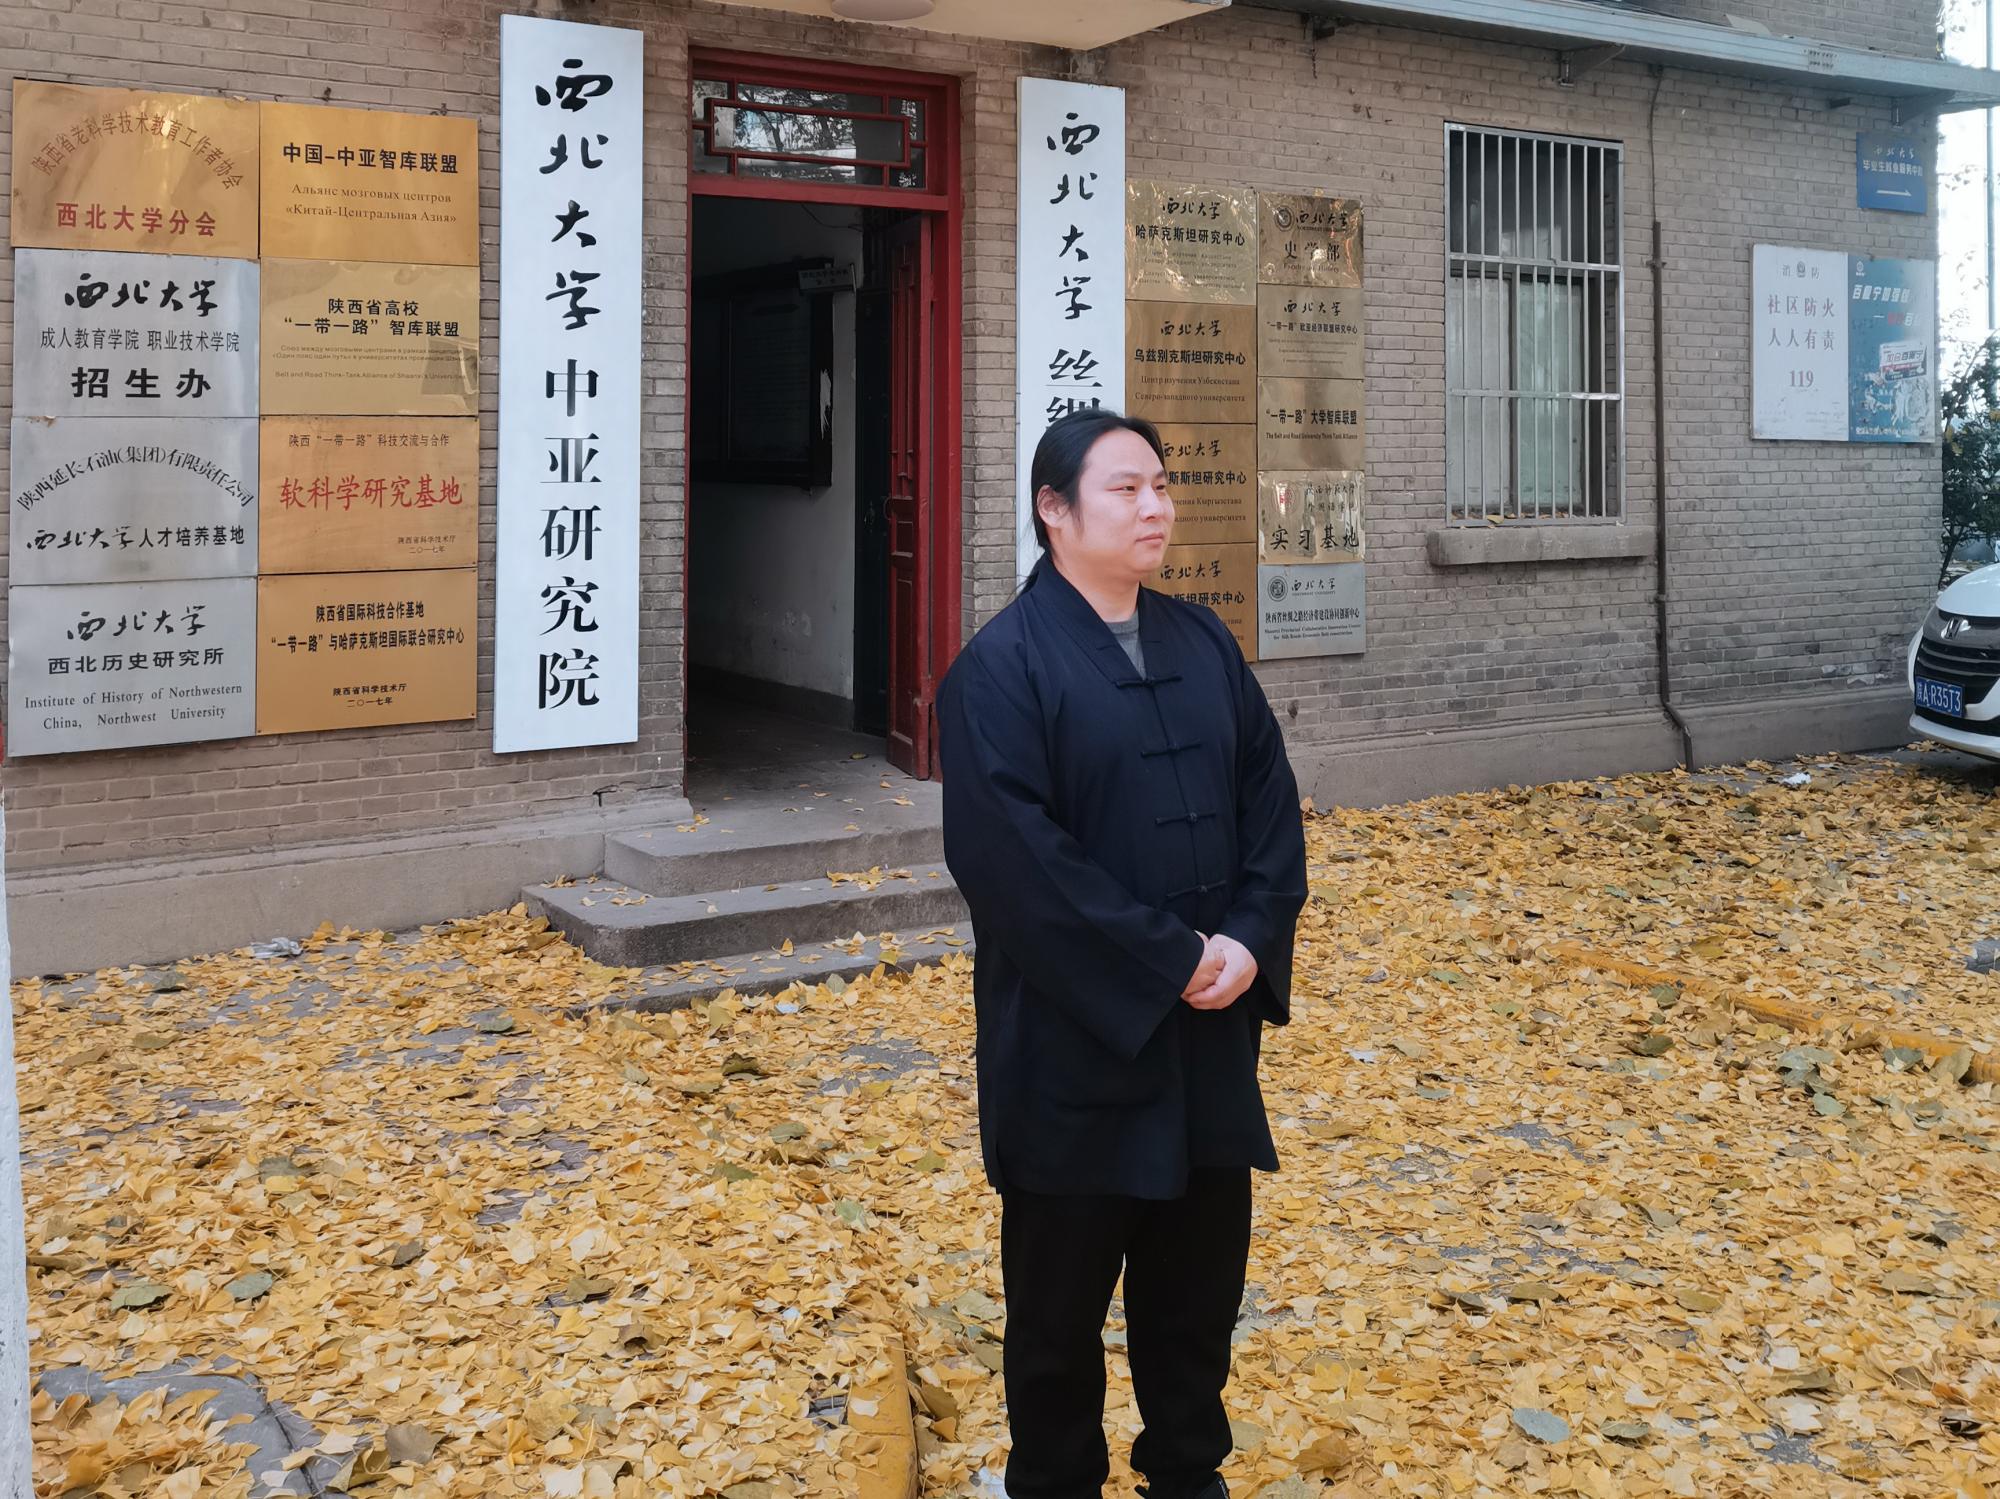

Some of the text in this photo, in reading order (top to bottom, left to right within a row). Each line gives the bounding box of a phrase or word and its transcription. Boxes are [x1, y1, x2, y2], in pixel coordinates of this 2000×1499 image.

[32, 111, 244, 190] 陕西省老科学技术教育工作者协会
[292, 184, 452, 204] Альянс мозговых центров
[56, 202, 216, 237] 西北大学分会
[1162, 197, 1221, 220] 西北大学
[1296, 210, 1348, 226] 西北大学
[1136, 224, 1246, 246] 哈萨克斯坦研究中心
[1782, 264, 1820, 280] 消 防
[64, 272, 218, 317] 西北大学
[1767, 294, 1836, 318] 社区防火
[328, 298, 420, 317] 陕西省高校
[1284, 300, 1341, 316] 西北大学
[40, 326, 240, 352] 成人教育学院 职业技术学院
[1160, 320, 1222, 337] 西北大学
[1768, 328, 1836, 352] 人人有责
[1134, 348, 1246, 366] 乌兹别克斯坦研究中心
[71, 366, 212, 398] 招生办
[535, 58, 614, 710] 西北大学中亚研究院
[1788, 370, 1814, 388] 119
[1164, 440, 1222, 458] 西北大学
[280, 474, 463, 512] 软科学研究基地
[26, 524, 245, 550] 西北大学人才培养基地
[1270, 524, 1360, 550] 实习基地
[1160, 560, 1222, 580] 西北大学
[1292, 578, 1336, 592] 西北大学
[67, 604, 207, 642] 西北大学
[316, 601, 424, 622] 陕西省国际科技合作基地
[48, 648, 224, 675] 西北历史研究所
[24, 684, 242, 708] Institute of History of Northwestern
[332, 683, 407, 696] 陕西省科学技术厅
[44, 706, 226, 730] China, Northwest University
